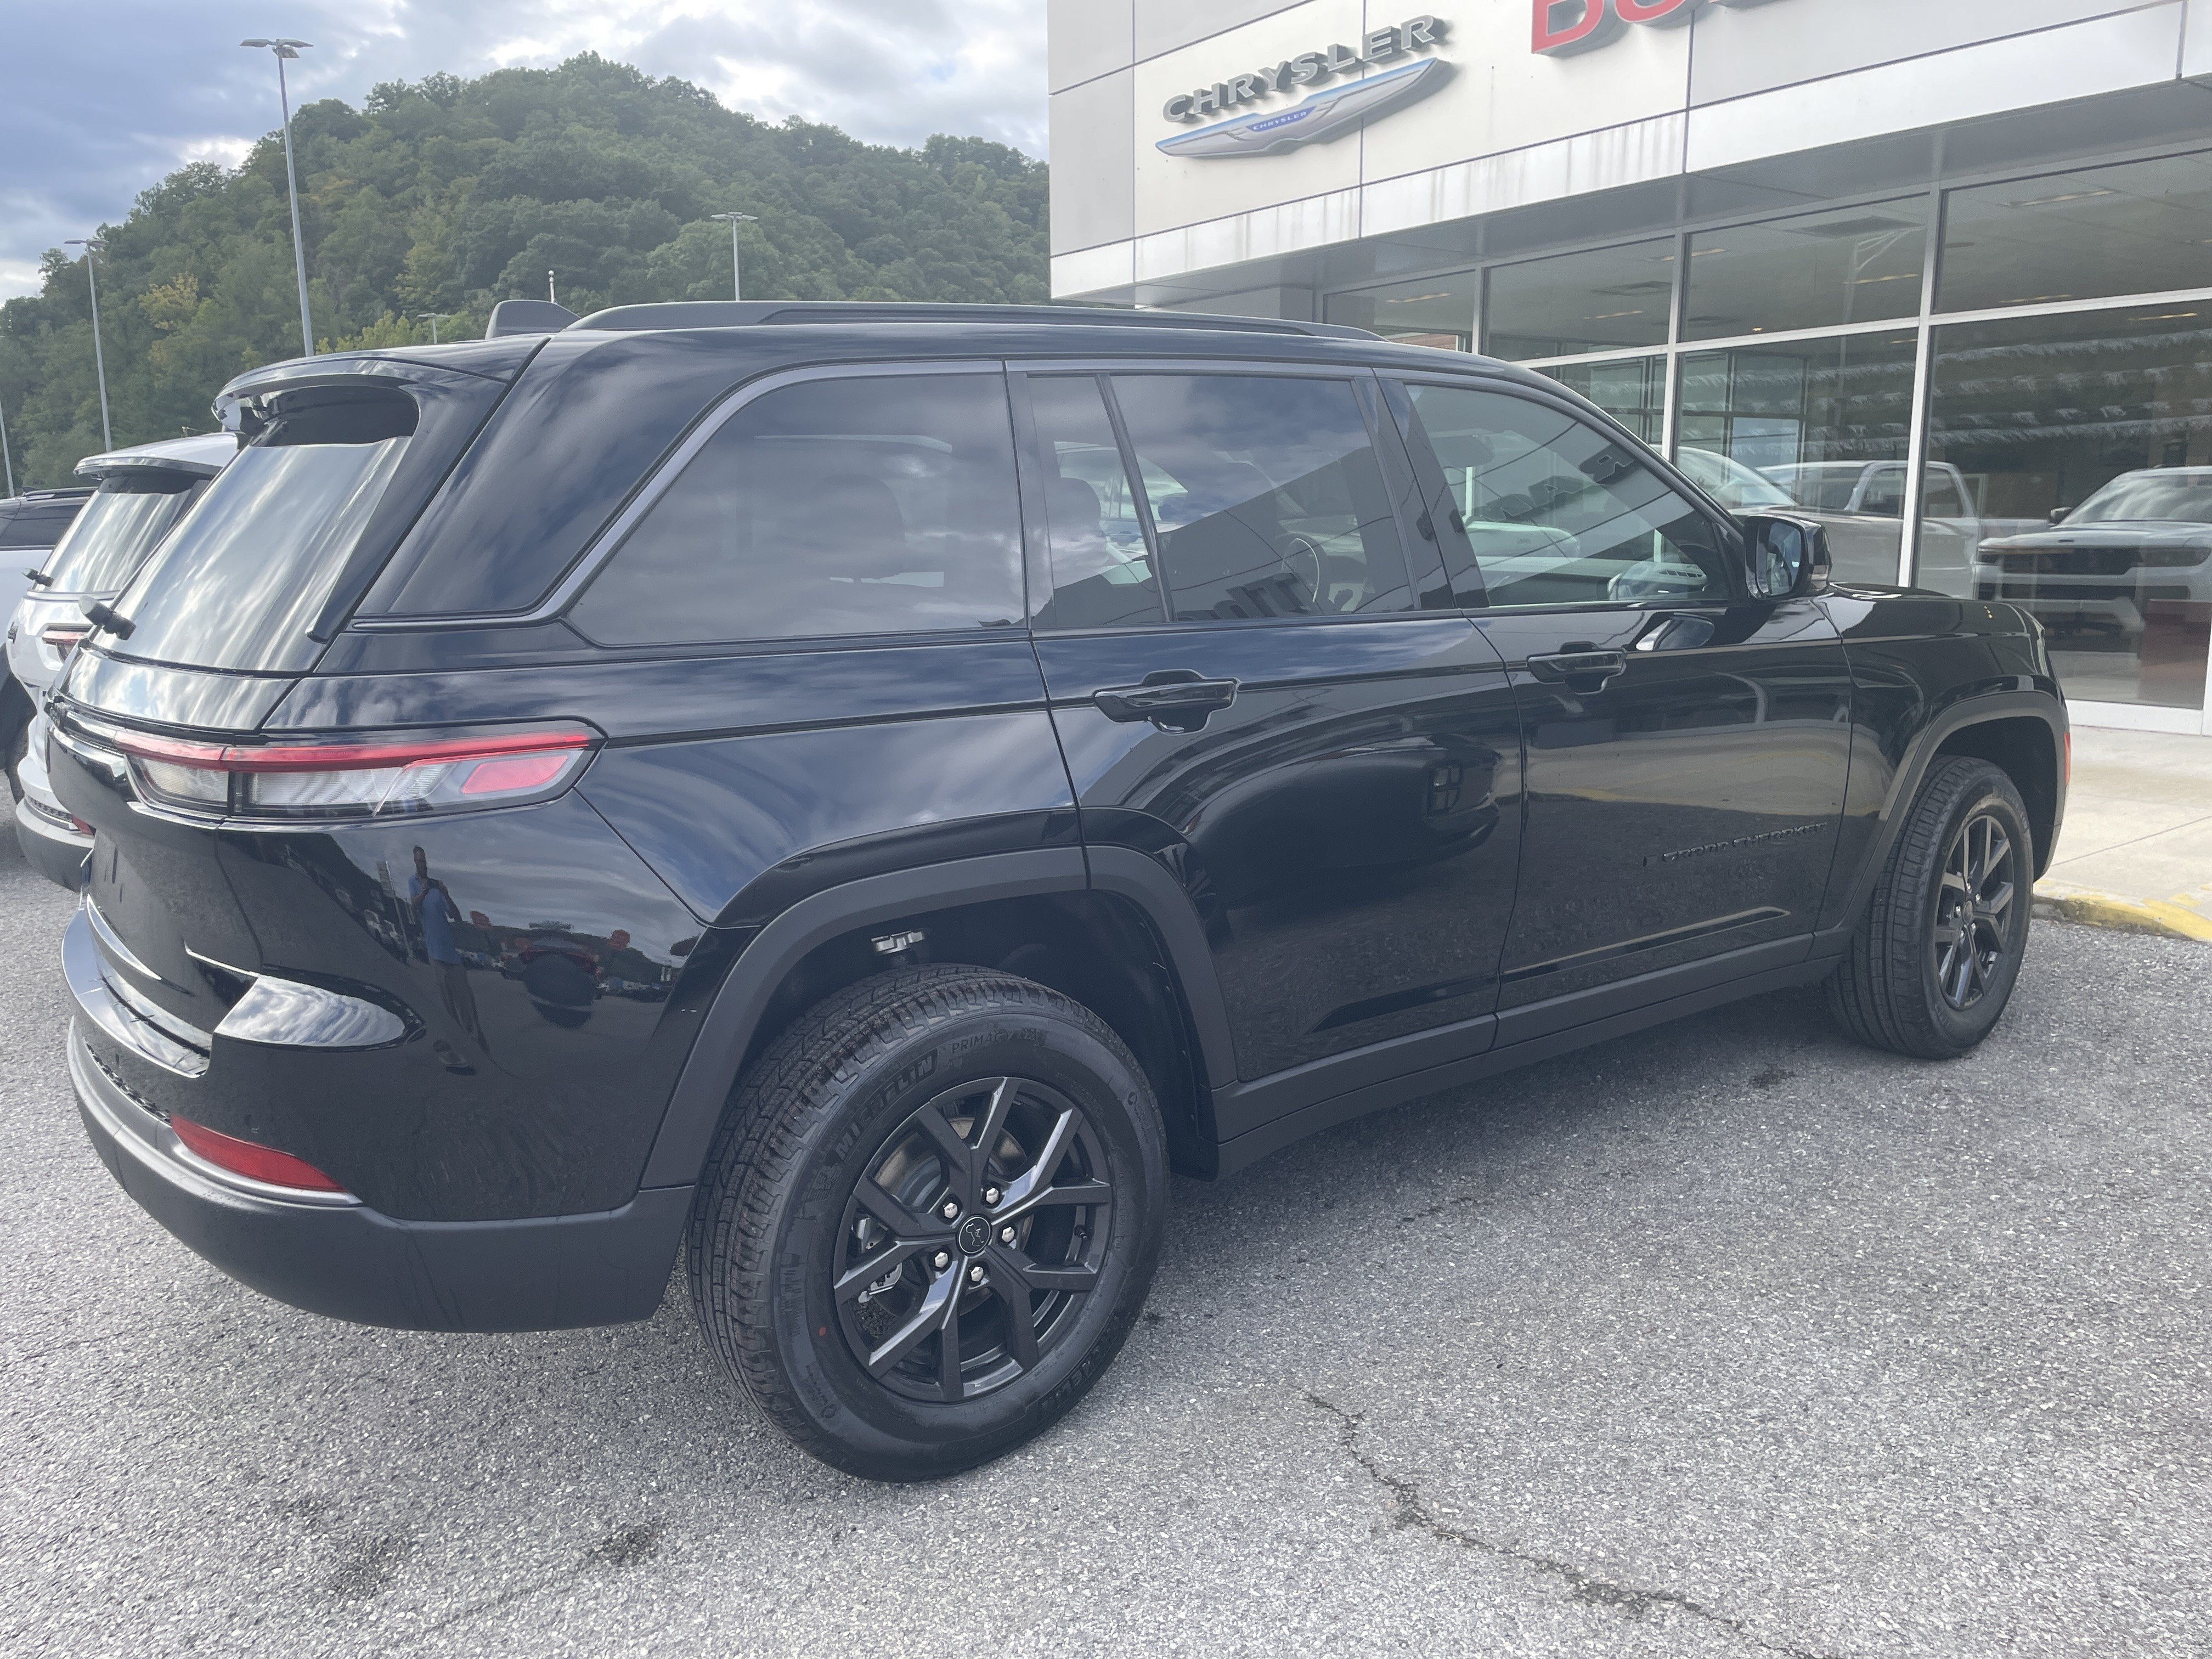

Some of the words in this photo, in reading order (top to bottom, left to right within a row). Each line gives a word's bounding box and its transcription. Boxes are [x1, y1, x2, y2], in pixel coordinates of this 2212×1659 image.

[1162, 14, 1436, 123] CHRYSLER
[1253, 111, 1307, 130] CHRYSLER
[834, 1055, 933, 1161] MICHELIN
